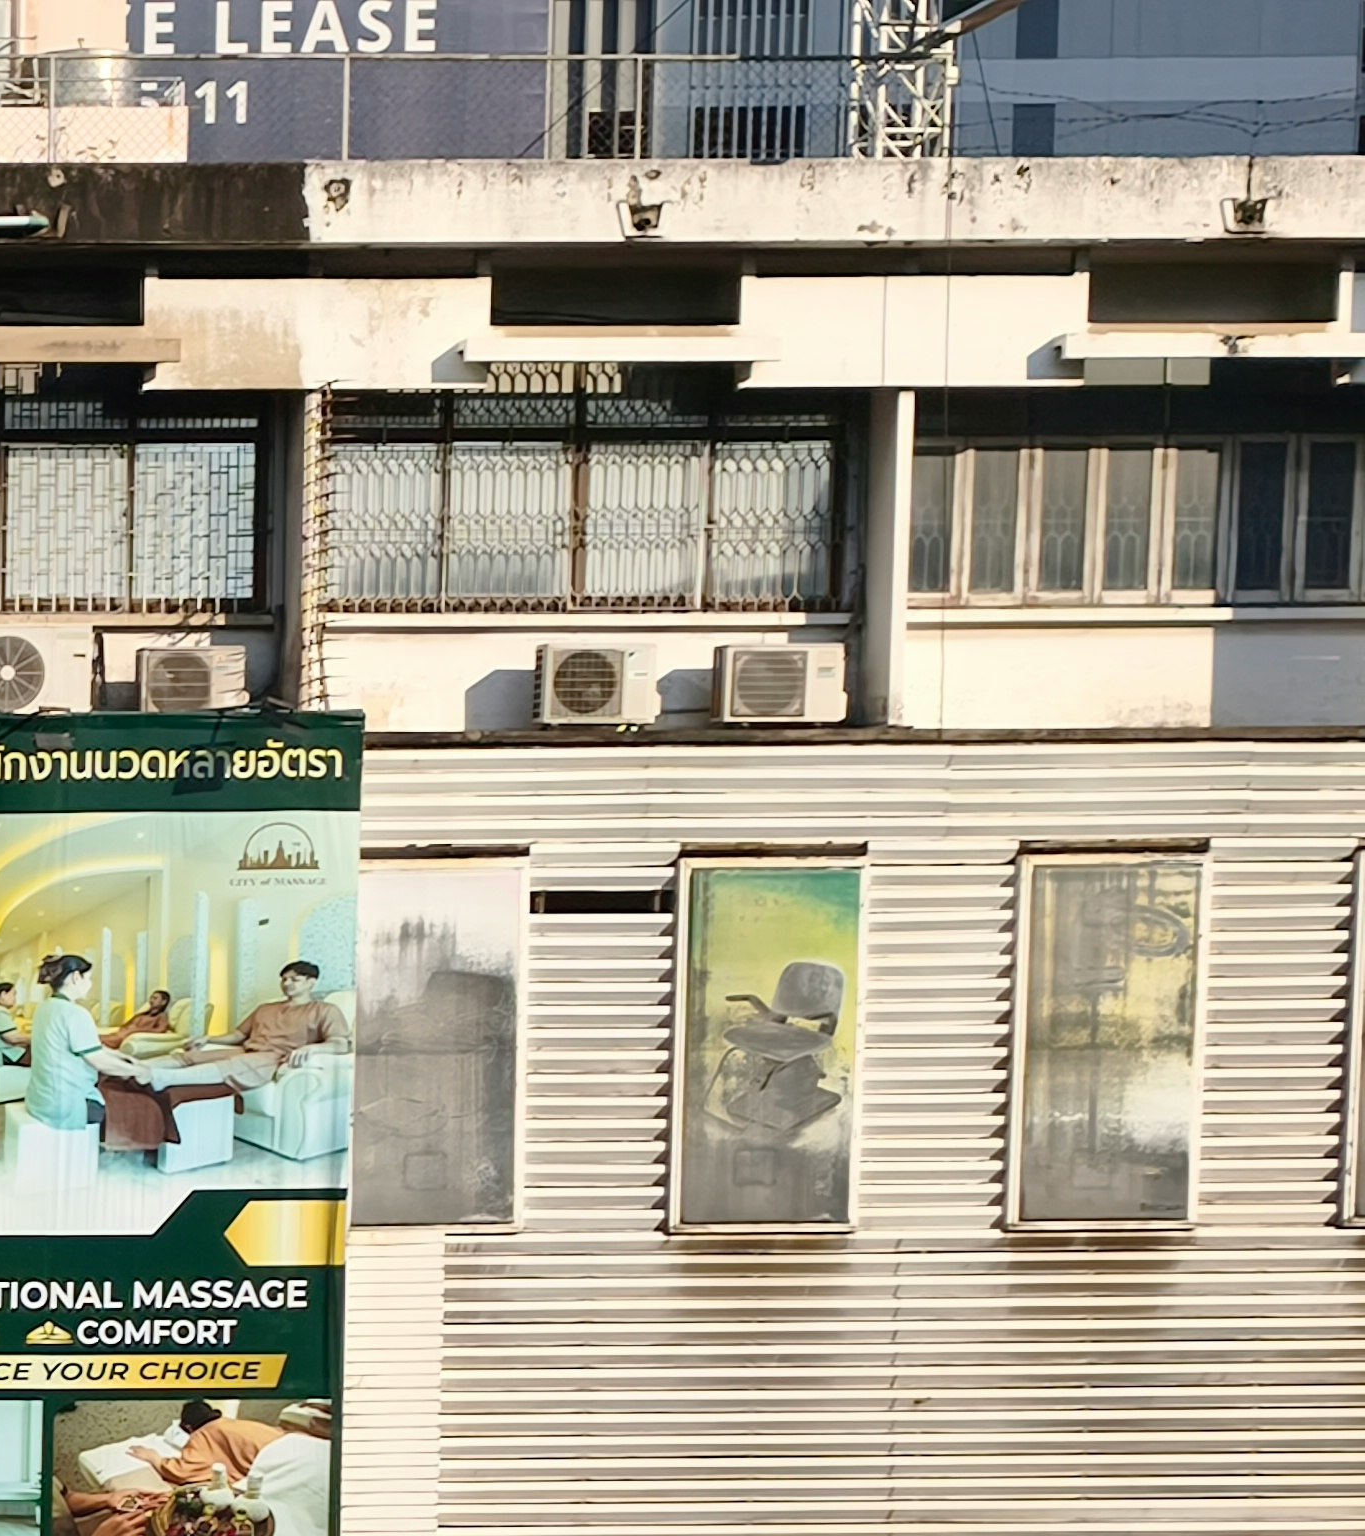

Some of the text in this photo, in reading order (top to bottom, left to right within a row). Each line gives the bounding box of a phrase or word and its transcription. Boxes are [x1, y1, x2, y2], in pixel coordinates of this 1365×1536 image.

[215, 1, 437, 54] LEASE
[132, 1279, 308, 1310] MASSAGE
[76, 1318, 238, 1346] COMFORT
[42, 1362, 130, 1381] YOUR
[138, 1361, 262, 1380] CHOICE
